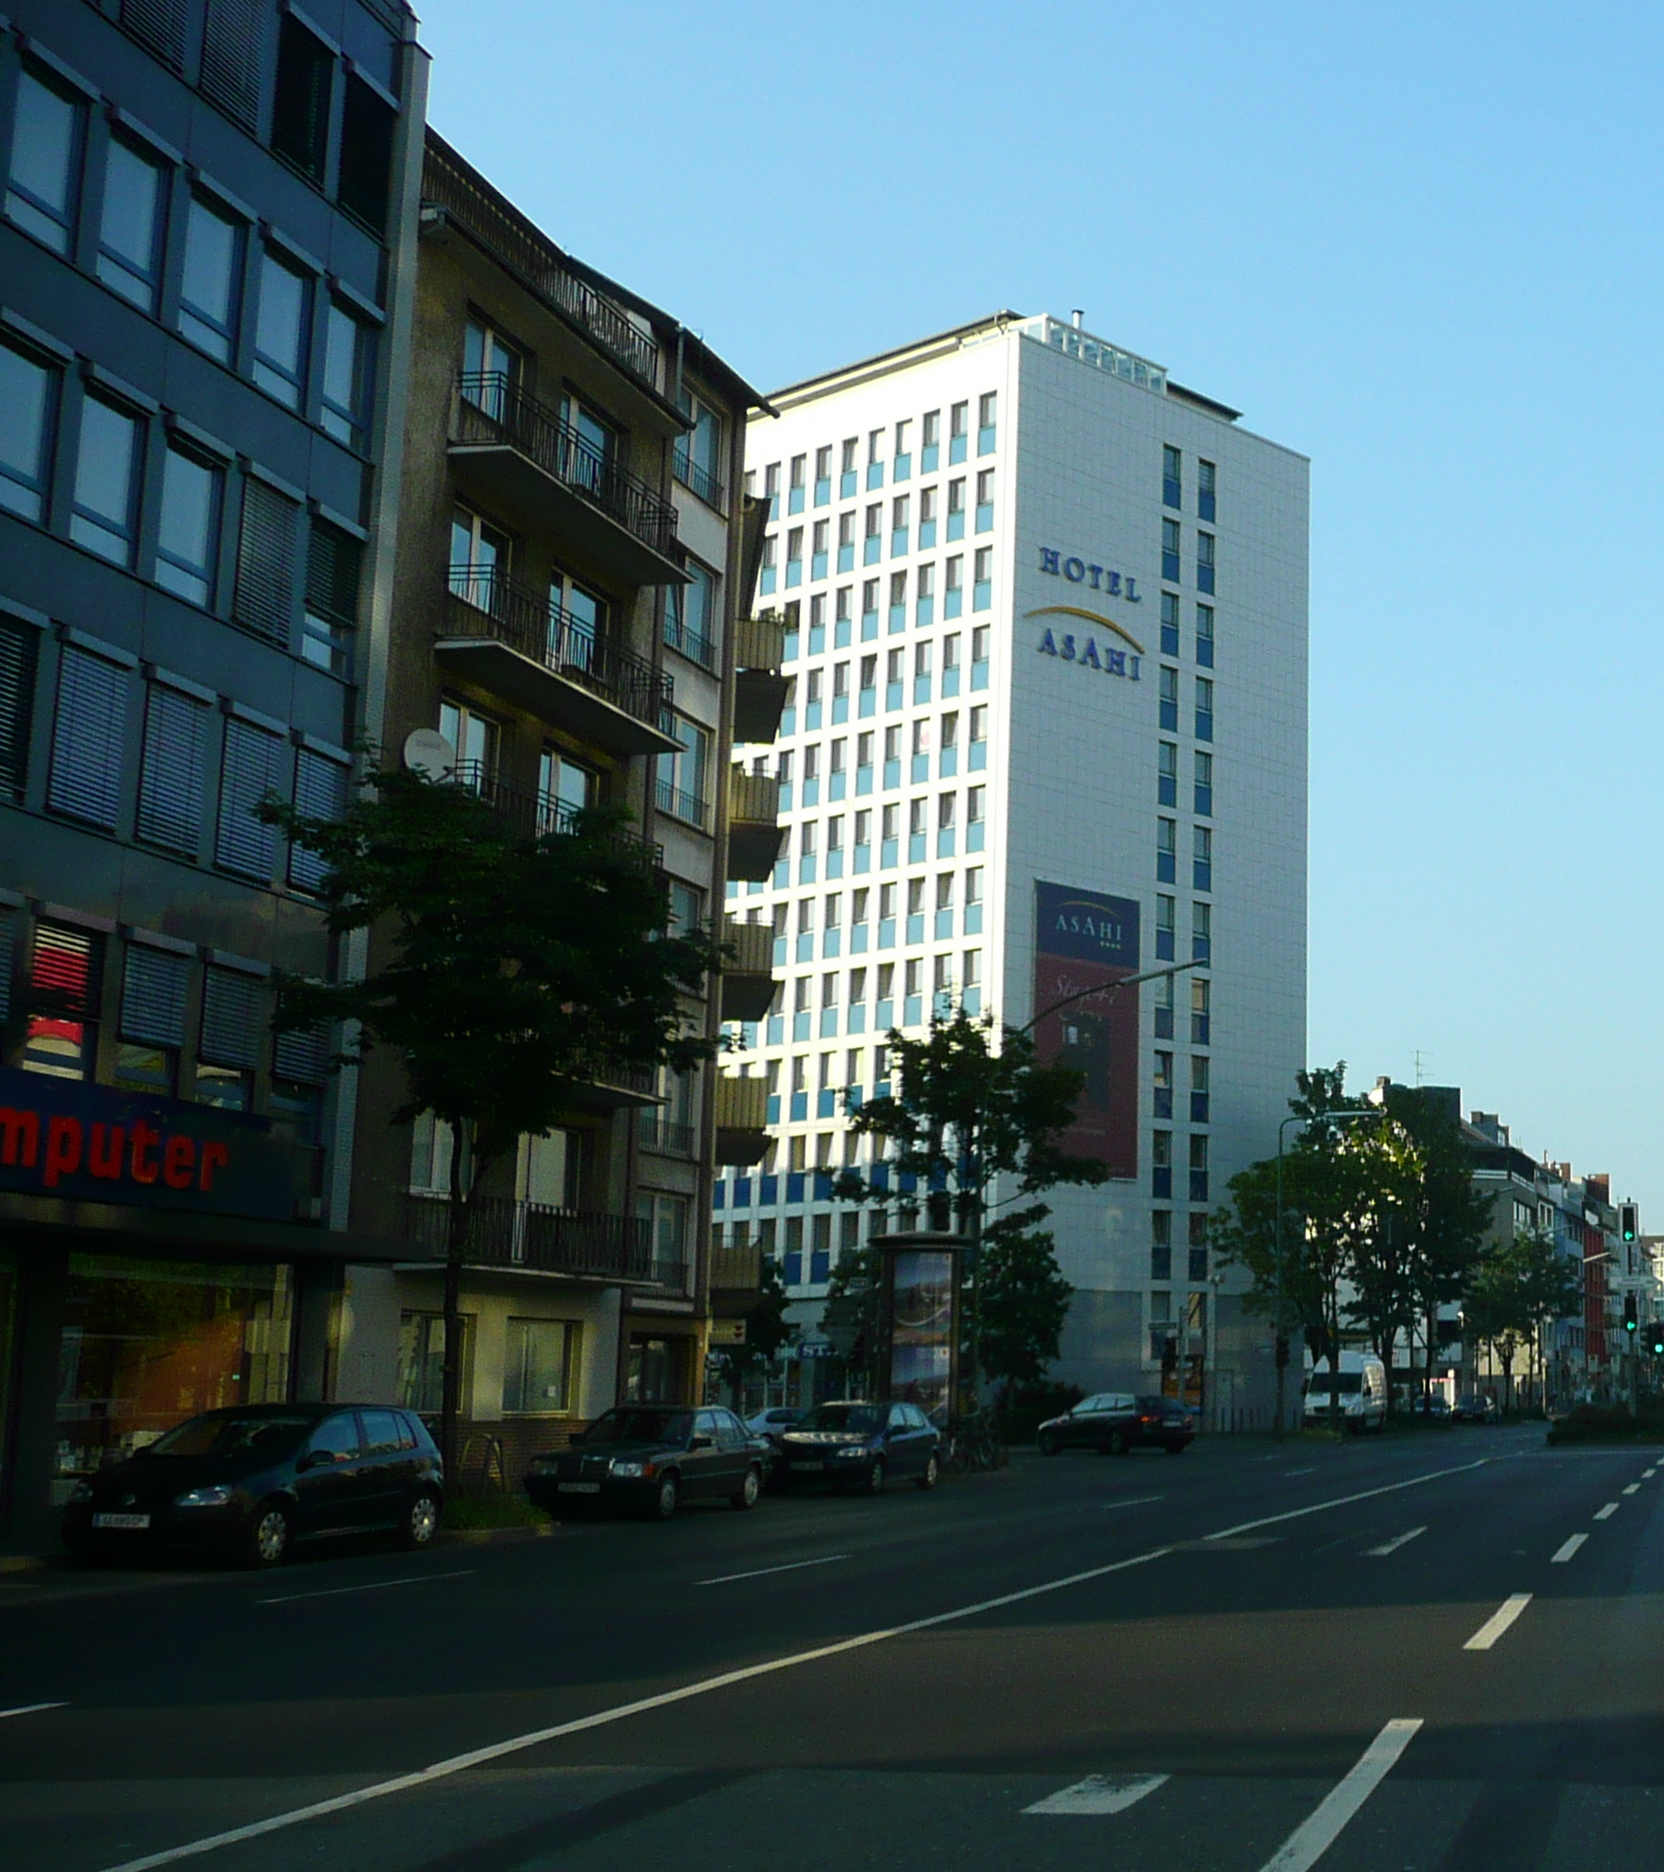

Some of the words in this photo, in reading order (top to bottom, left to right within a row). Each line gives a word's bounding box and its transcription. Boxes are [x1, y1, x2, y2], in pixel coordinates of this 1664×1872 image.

[1039, 547, 1142, 602] HOTEL
[1037, 627, 1142, 681] ASAHI
[1056, 914, 1122, 941] ASAHI
